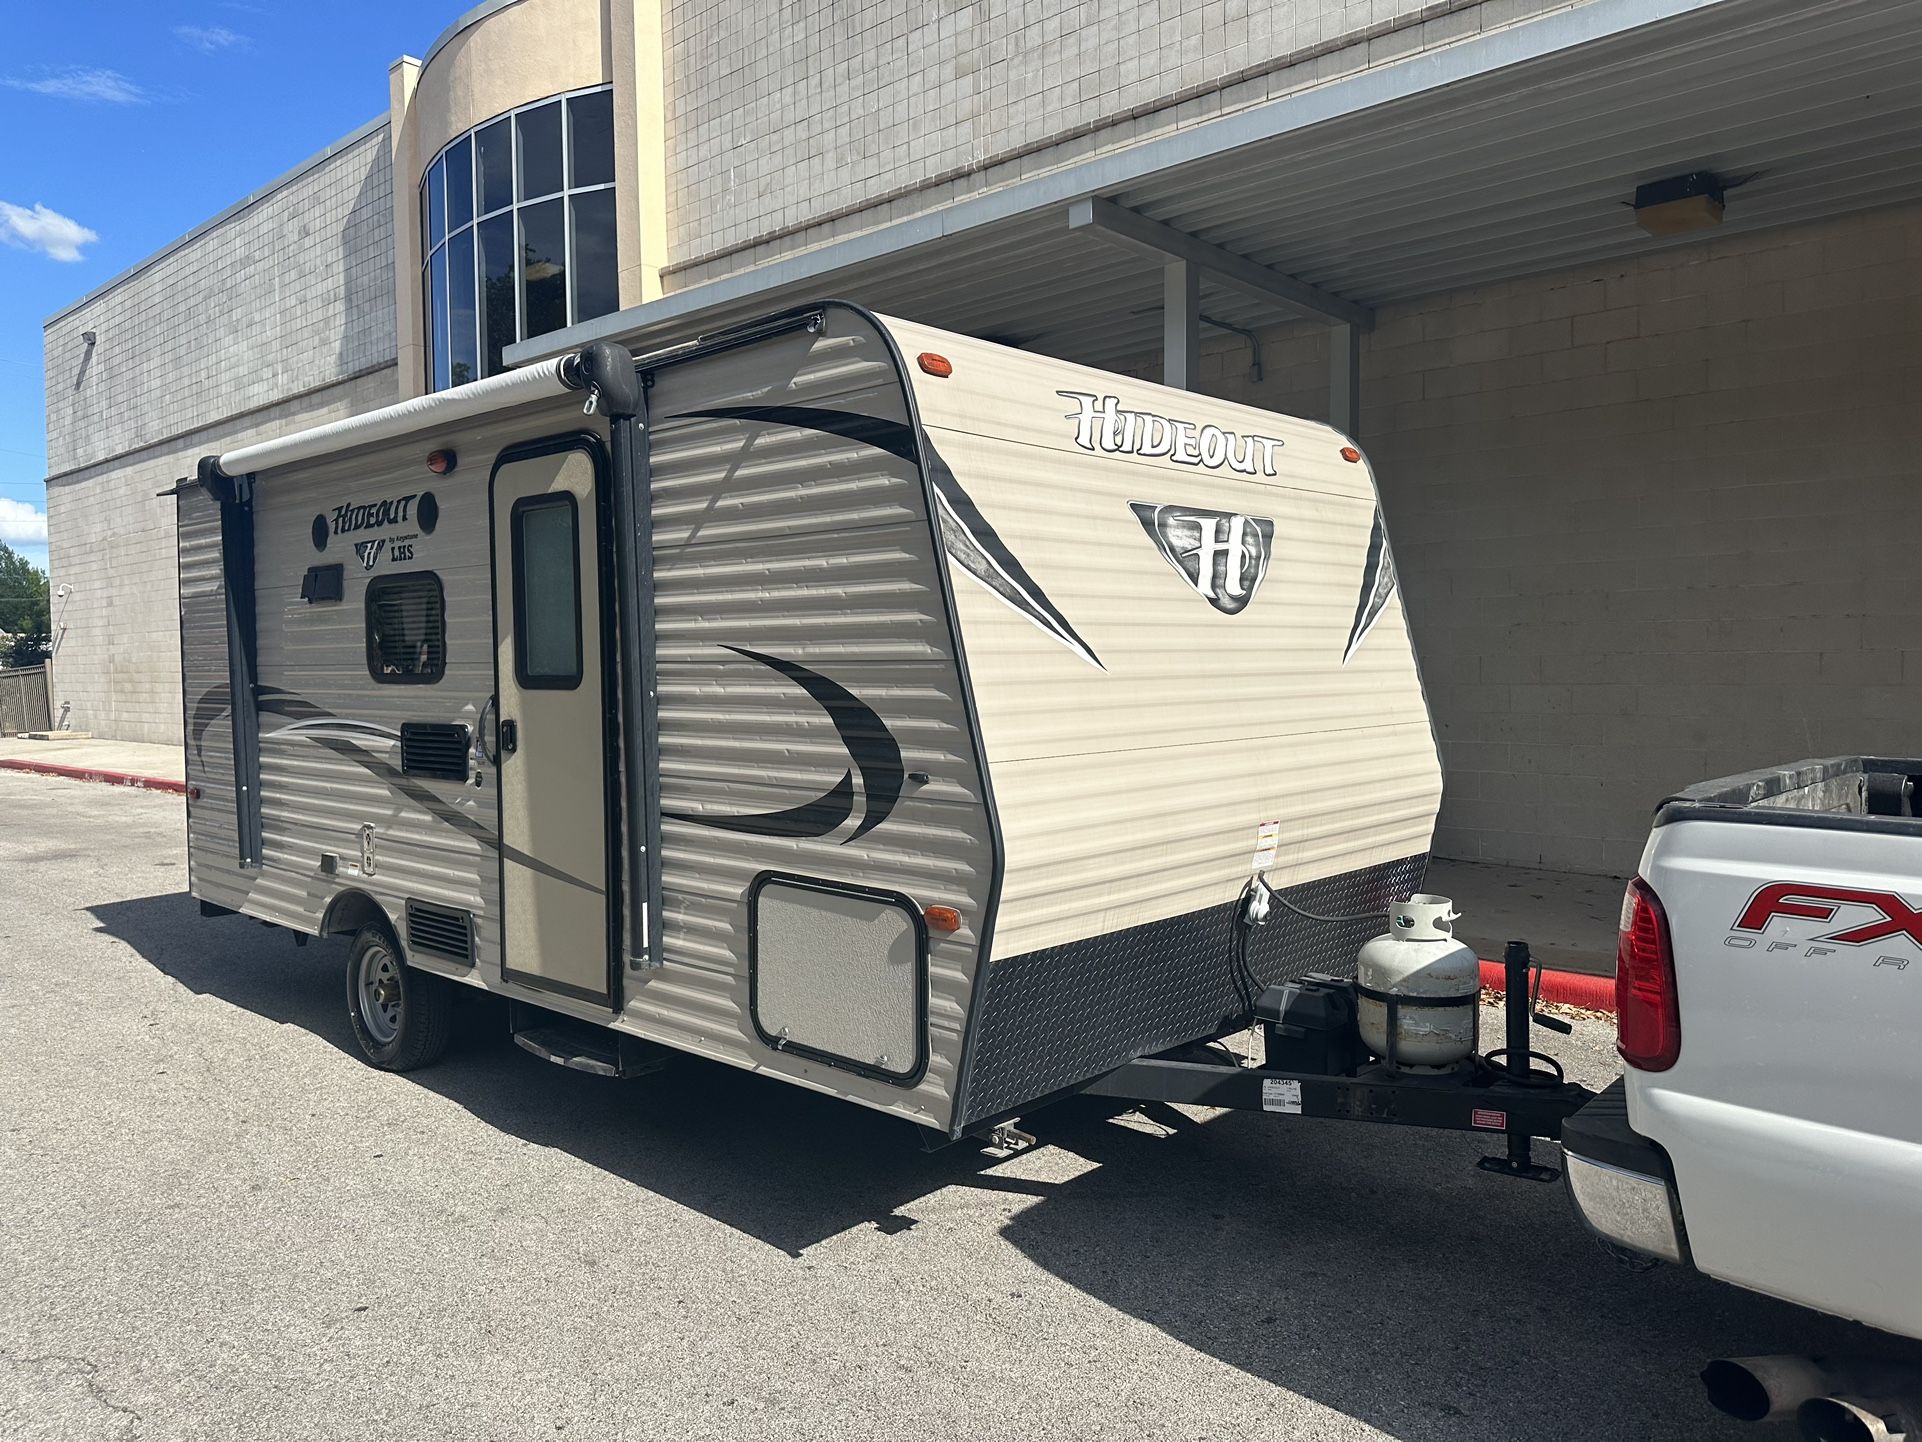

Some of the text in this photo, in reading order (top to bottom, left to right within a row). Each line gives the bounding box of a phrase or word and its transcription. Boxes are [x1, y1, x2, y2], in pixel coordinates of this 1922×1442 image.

[1056, 390, 1284, 476] HIDEOUT
[331, 494, 418, 535] HIDEOUT
[391, 544, 414, 561] LHS
[1170, 514, 1251, 599] H
[1724, 935, 1836, 957] OFF
